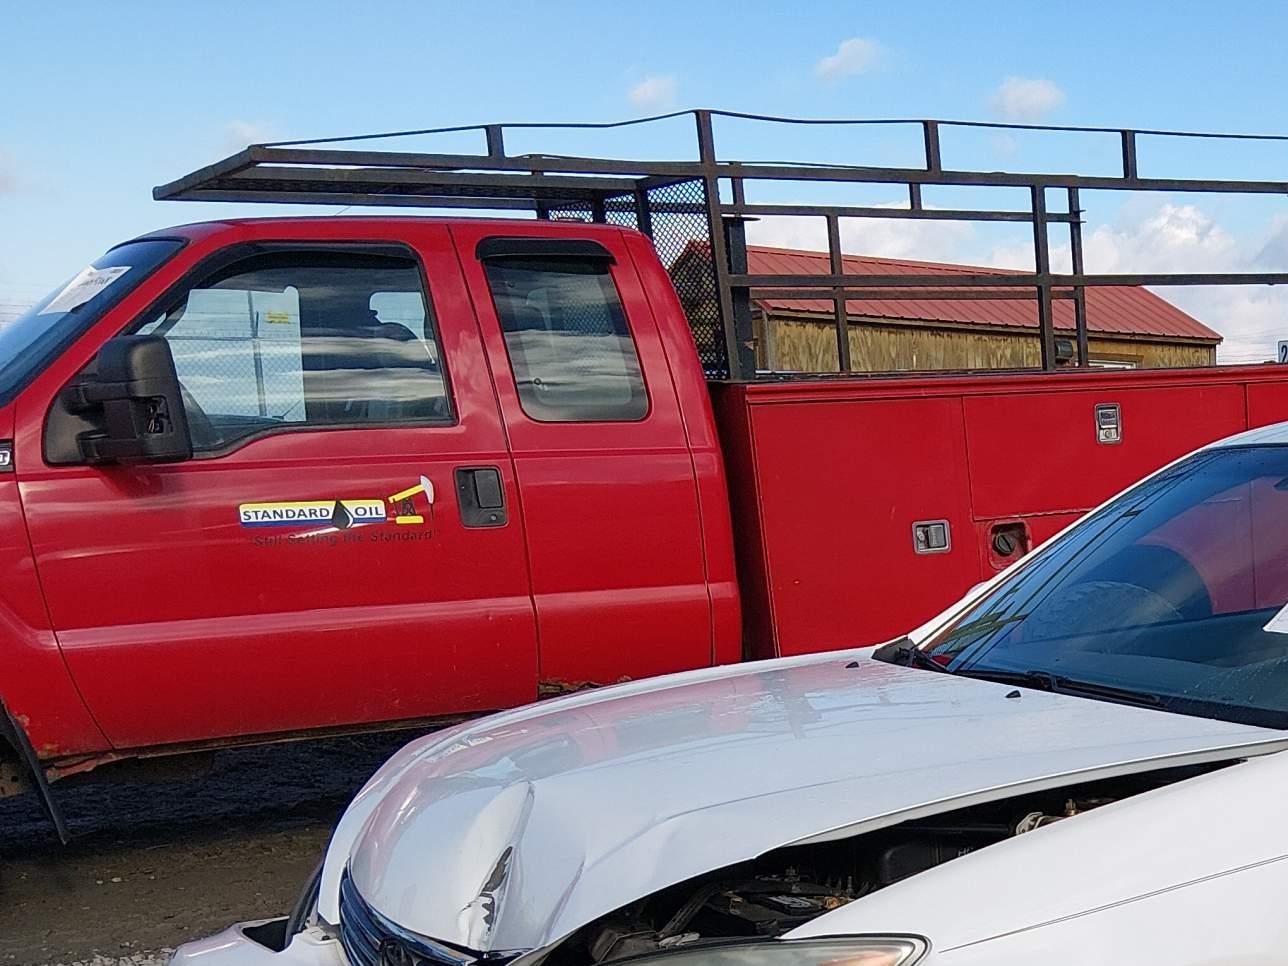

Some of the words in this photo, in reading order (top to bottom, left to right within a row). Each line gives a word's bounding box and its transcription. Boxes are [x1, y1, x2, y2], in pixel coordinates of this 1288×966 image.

[1281, 344, 1288, 362] 2
[243, 508, 330, 521] STANDARD
[354, 506, 383, 516] OIL
[288, 532, 337, 547] Setting
[343, 530, 363, 541] the
